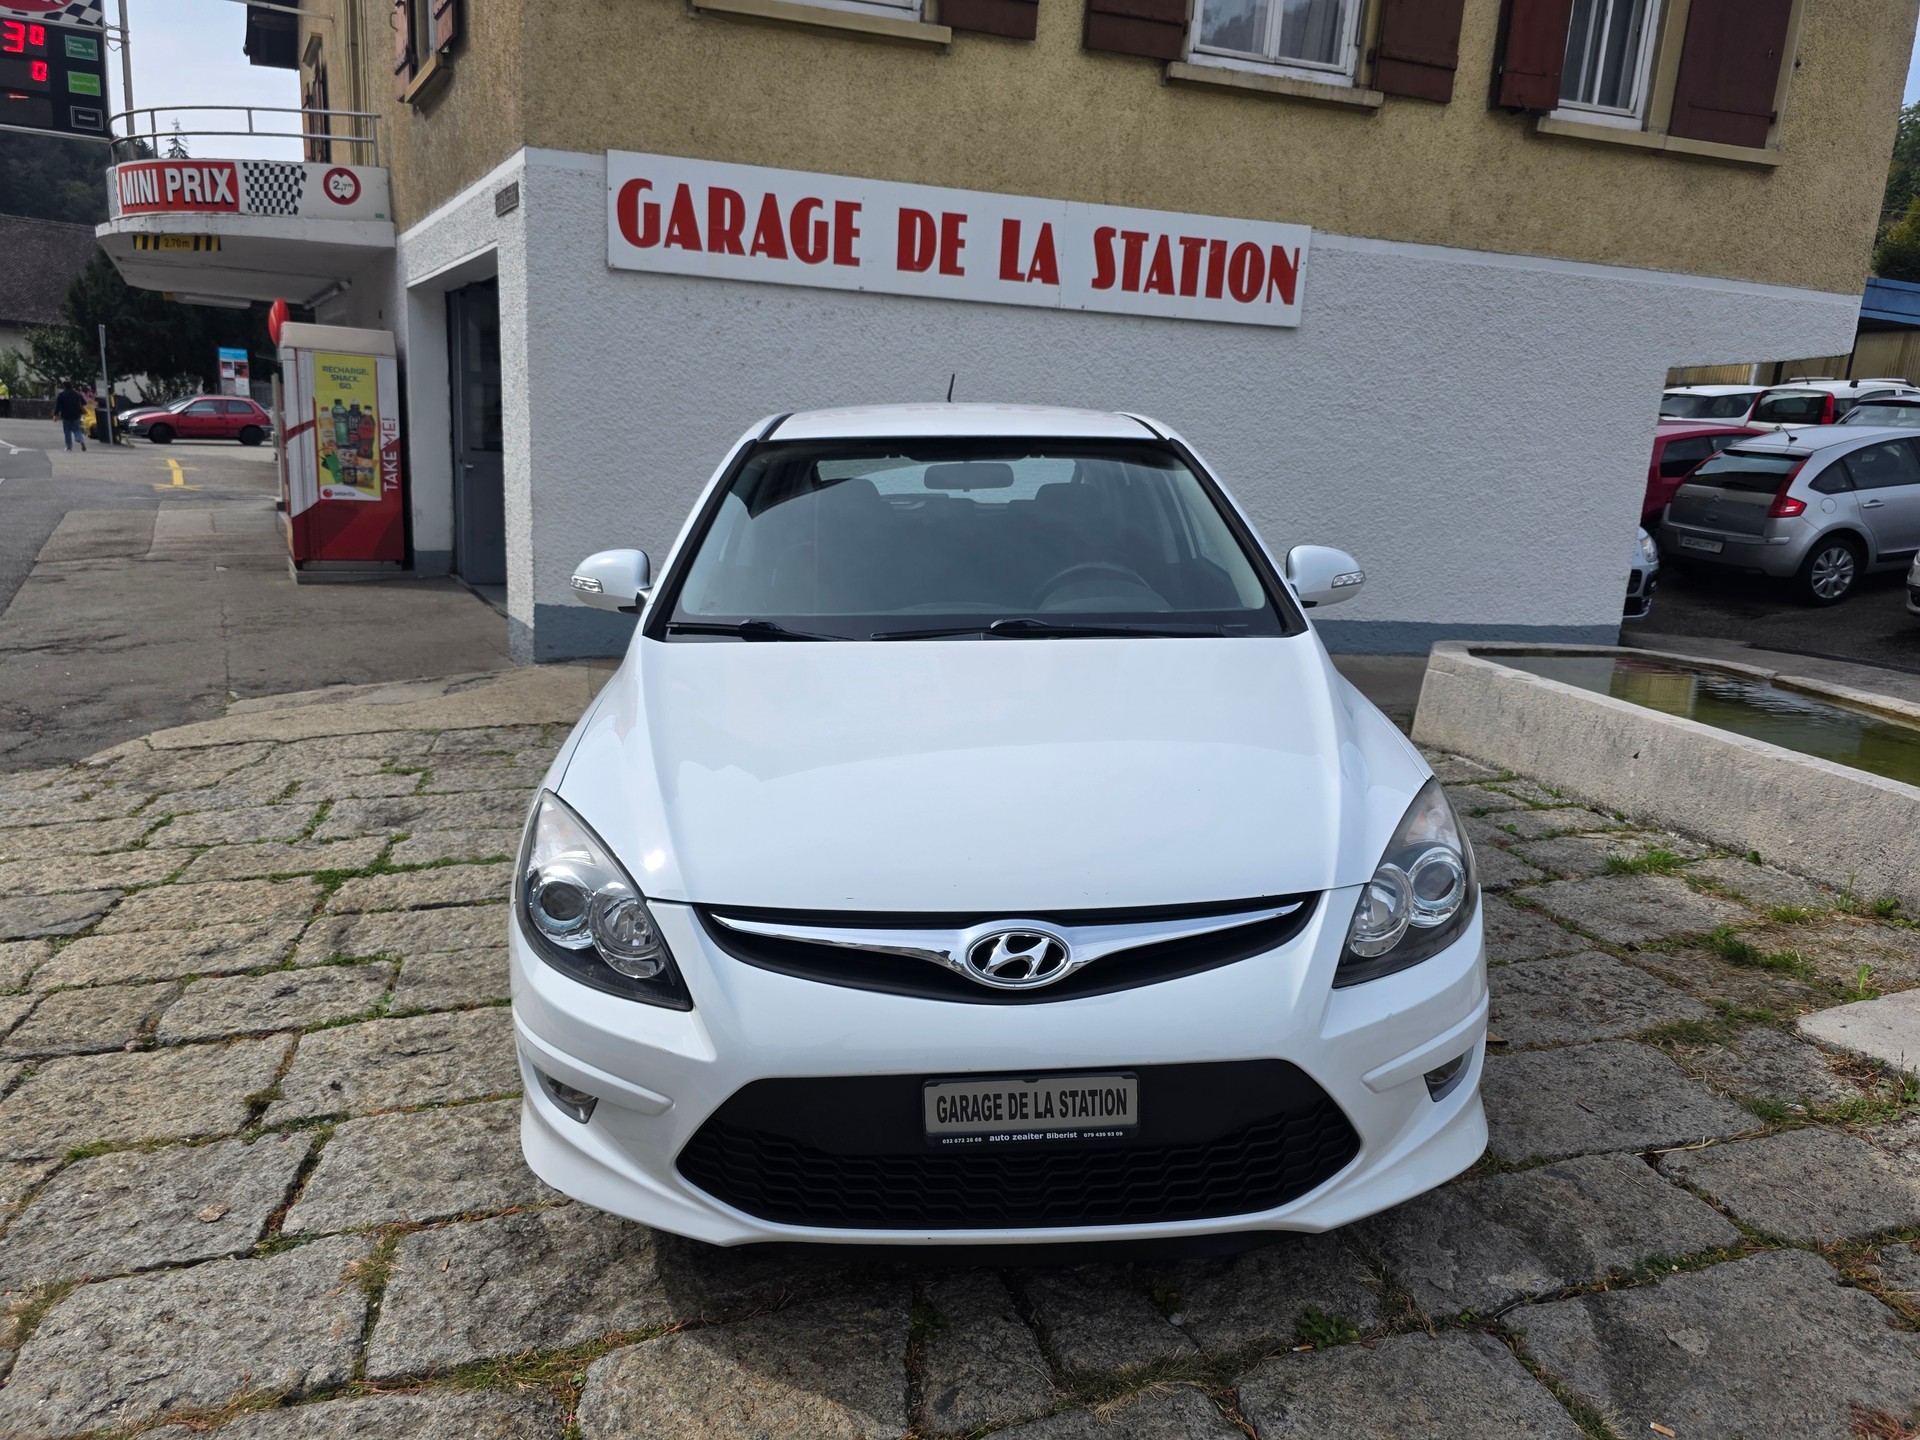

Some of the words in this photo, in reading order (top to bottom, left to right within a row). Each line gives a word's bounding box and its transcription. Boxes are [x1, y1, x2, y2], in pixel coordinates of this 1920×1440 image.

[120, 167, 160, 206] MINI
[164, 167, 235, 204] PRIX
[616, 178, 864, 268] GARAGE
[896, 207, 969, 277] DE
[999, 218, 1060, 285] LA
[1090, 225, 1301, 306] STATION
[382, 416, 398, 448] ME!
[383, 451, 399, 493] TAKE
[936, 1093, 1003, 1124] GARAGE
[1008, 1092, 1029, 1120] DE
[1034, 1091, 1055, 1119] LA
[1059, 1088, 1127, 1117] STATION
[989, 1134, 1010, 1142] auto
[1046, 1131, 1078, 1140] Biberist
